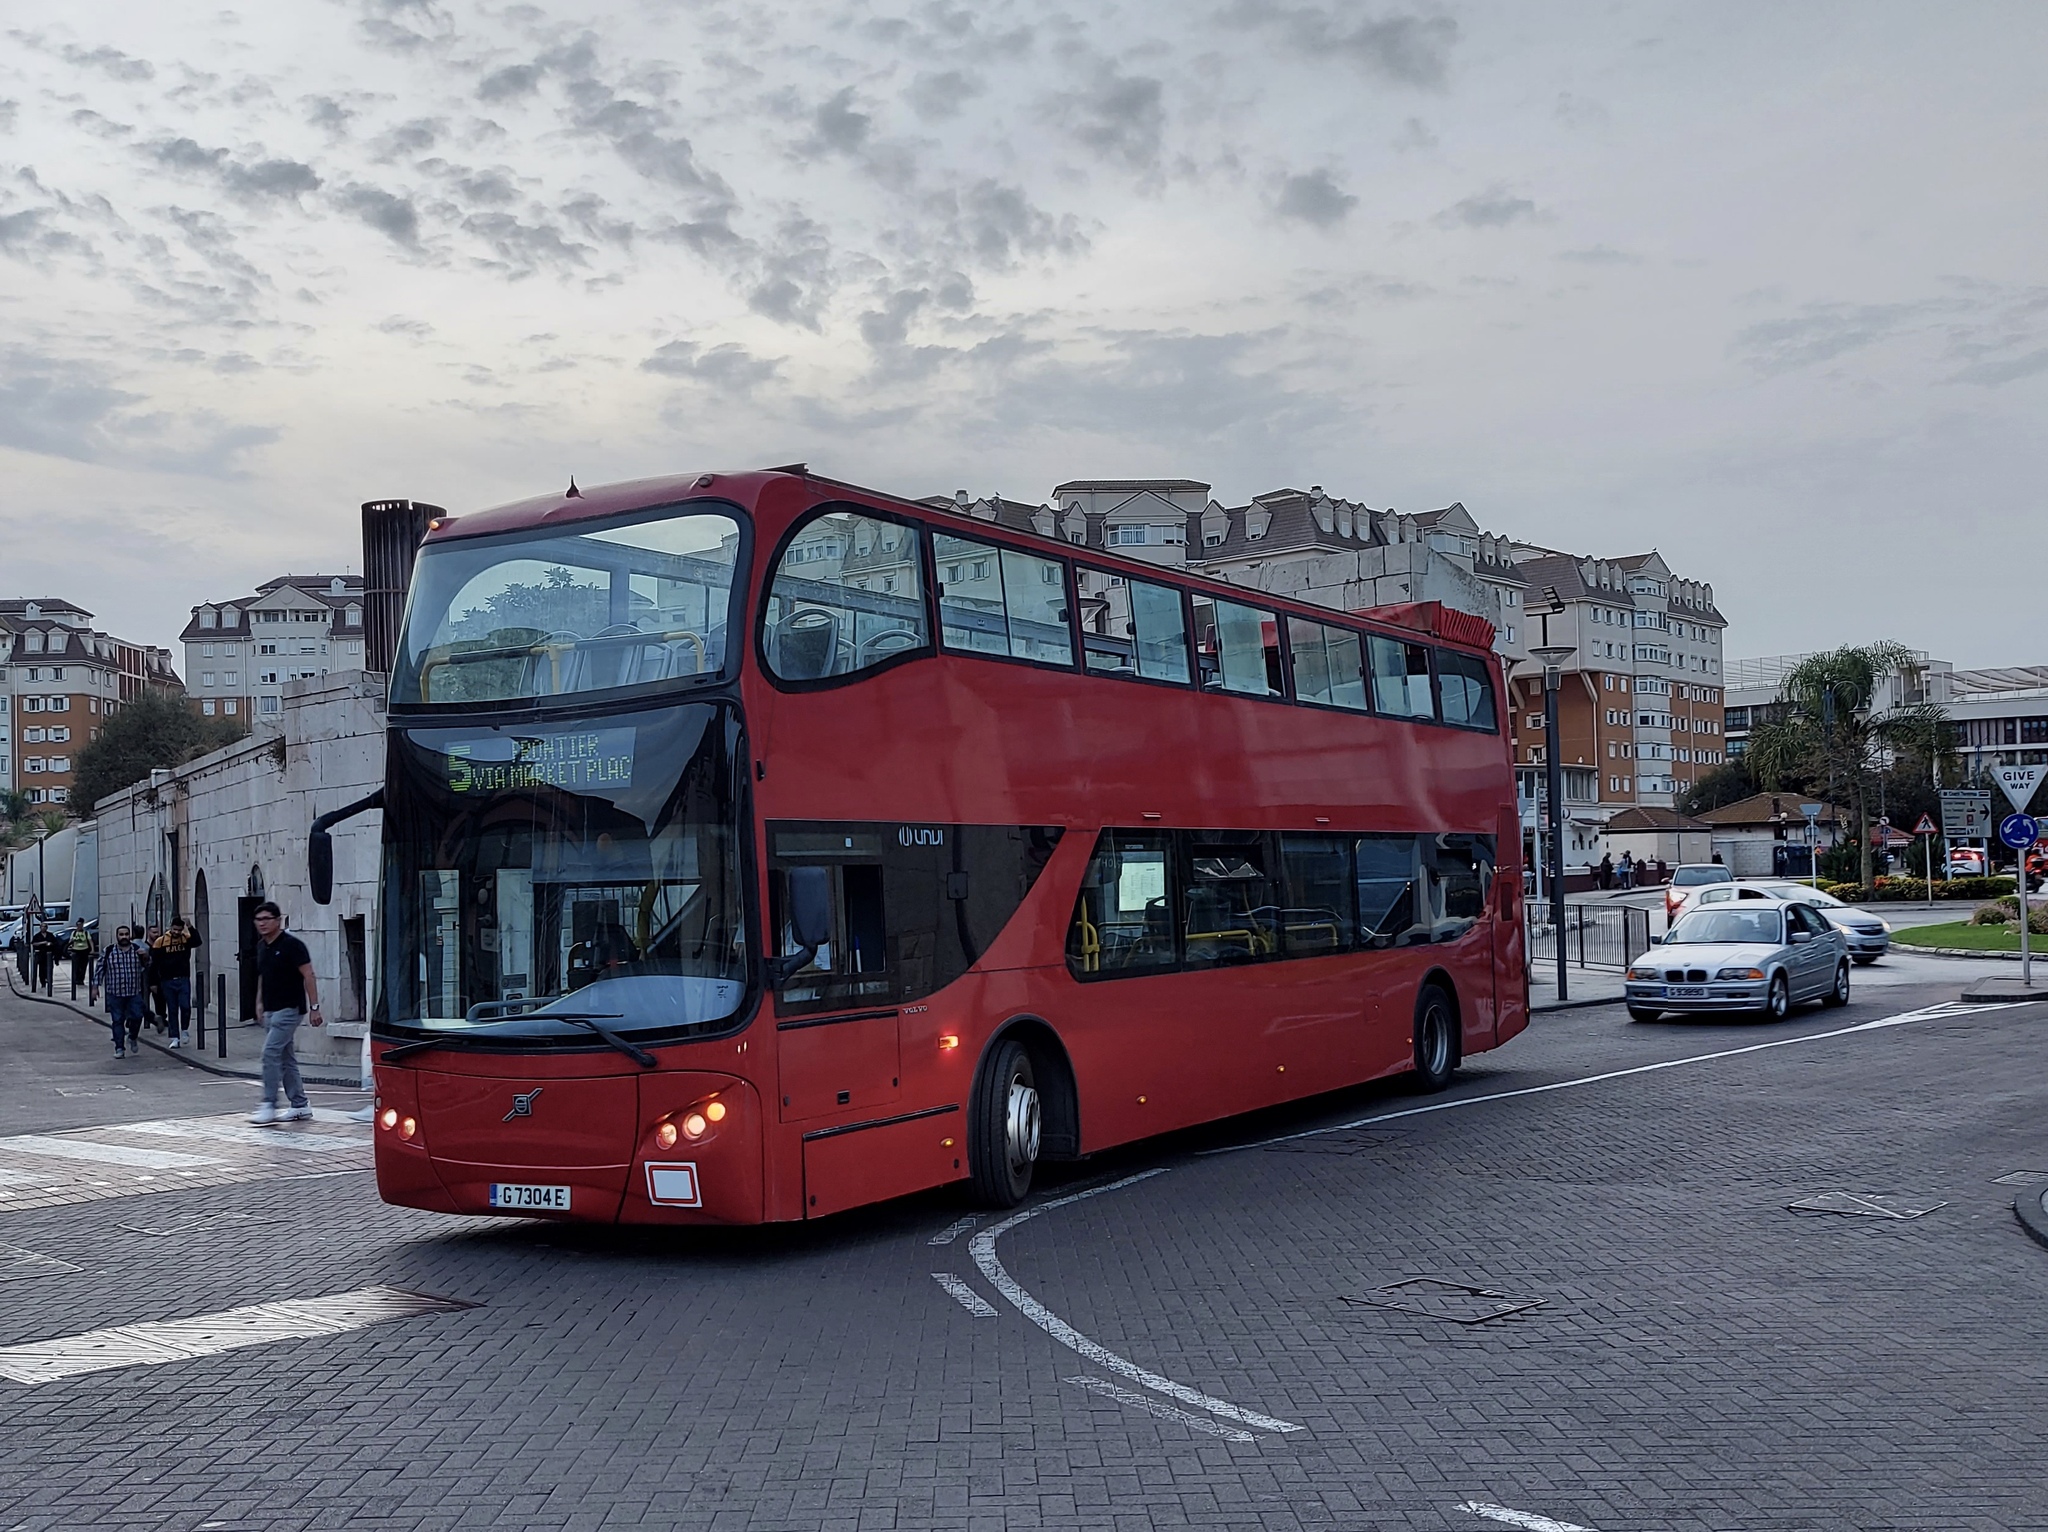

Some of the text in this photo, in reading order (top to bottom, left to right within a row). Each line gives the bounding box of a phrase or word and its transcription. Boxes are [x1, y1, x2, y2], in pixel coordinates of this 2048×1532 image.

[512, 734, 599, 763] FRONTIER
[448, 745, 472, 792] 5
[472, 766, 506, 790] VIA
[510, 760, 581, 788] MARKET
[2002, 770, 2035, 781] GIVE
[2010, 782, 2031, 790] WAY
[902, 1004, 928, 1014] VOLVO
